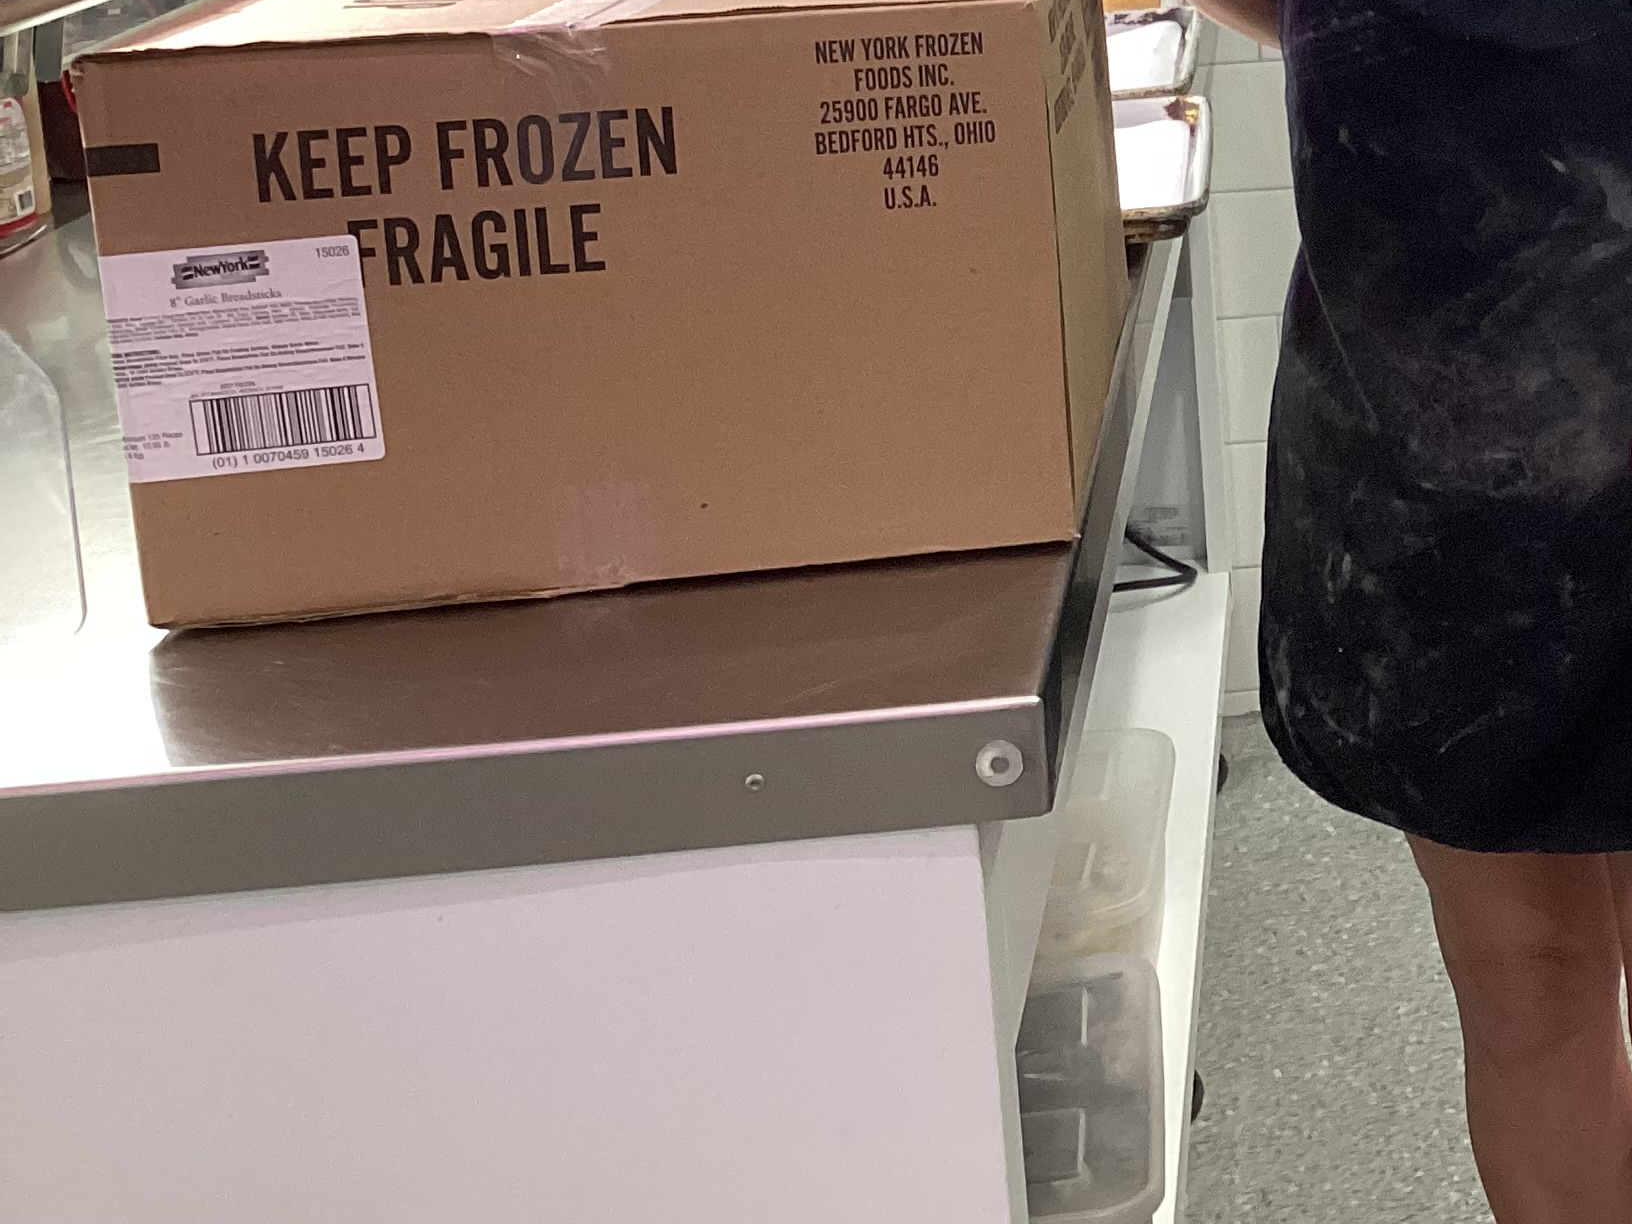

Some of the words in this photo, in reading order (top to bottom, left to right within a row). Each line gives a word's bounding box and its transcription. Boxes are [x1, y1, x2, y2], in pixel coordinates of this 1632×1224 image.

[815, 39, 855, 64] NEW
[861, 36, 910, 61] YORK
[915, 32, 983, 58] FROZEN
[854, 65, 912, 92] FOODS
[918, 63, 954, 87] INC.
[820, 98, 878, 124] 25900
[884, 94, 942, 120] FARGO
[949, 91, 987, 116] AVE.
[815, 127, 897, 155] BEDFORD
[903, 124, 949, 150] HTS.,
[954, 120, 996, 145] OHIO
[253, 124, 412, 203] KEEP
[436, 106, 678, 191] FROZEN
[883, 155, 939, 179] 44146
[884, 185, 937, 210] U.S.A.
[315, 245, 350, 259] 15026
[347, 203, 607, 288] FRAGILE
[184, 292, 219, 307] Garlic
[221, 288, 283, 303] Breadsticks
[212, 456, 238, 470] (01)
[243, 455, 249, 465] 1
[253, 448, 310, 464] 0070459
[314, 444, 354, 458] 15026
[356, 442, 365, 453] 4
